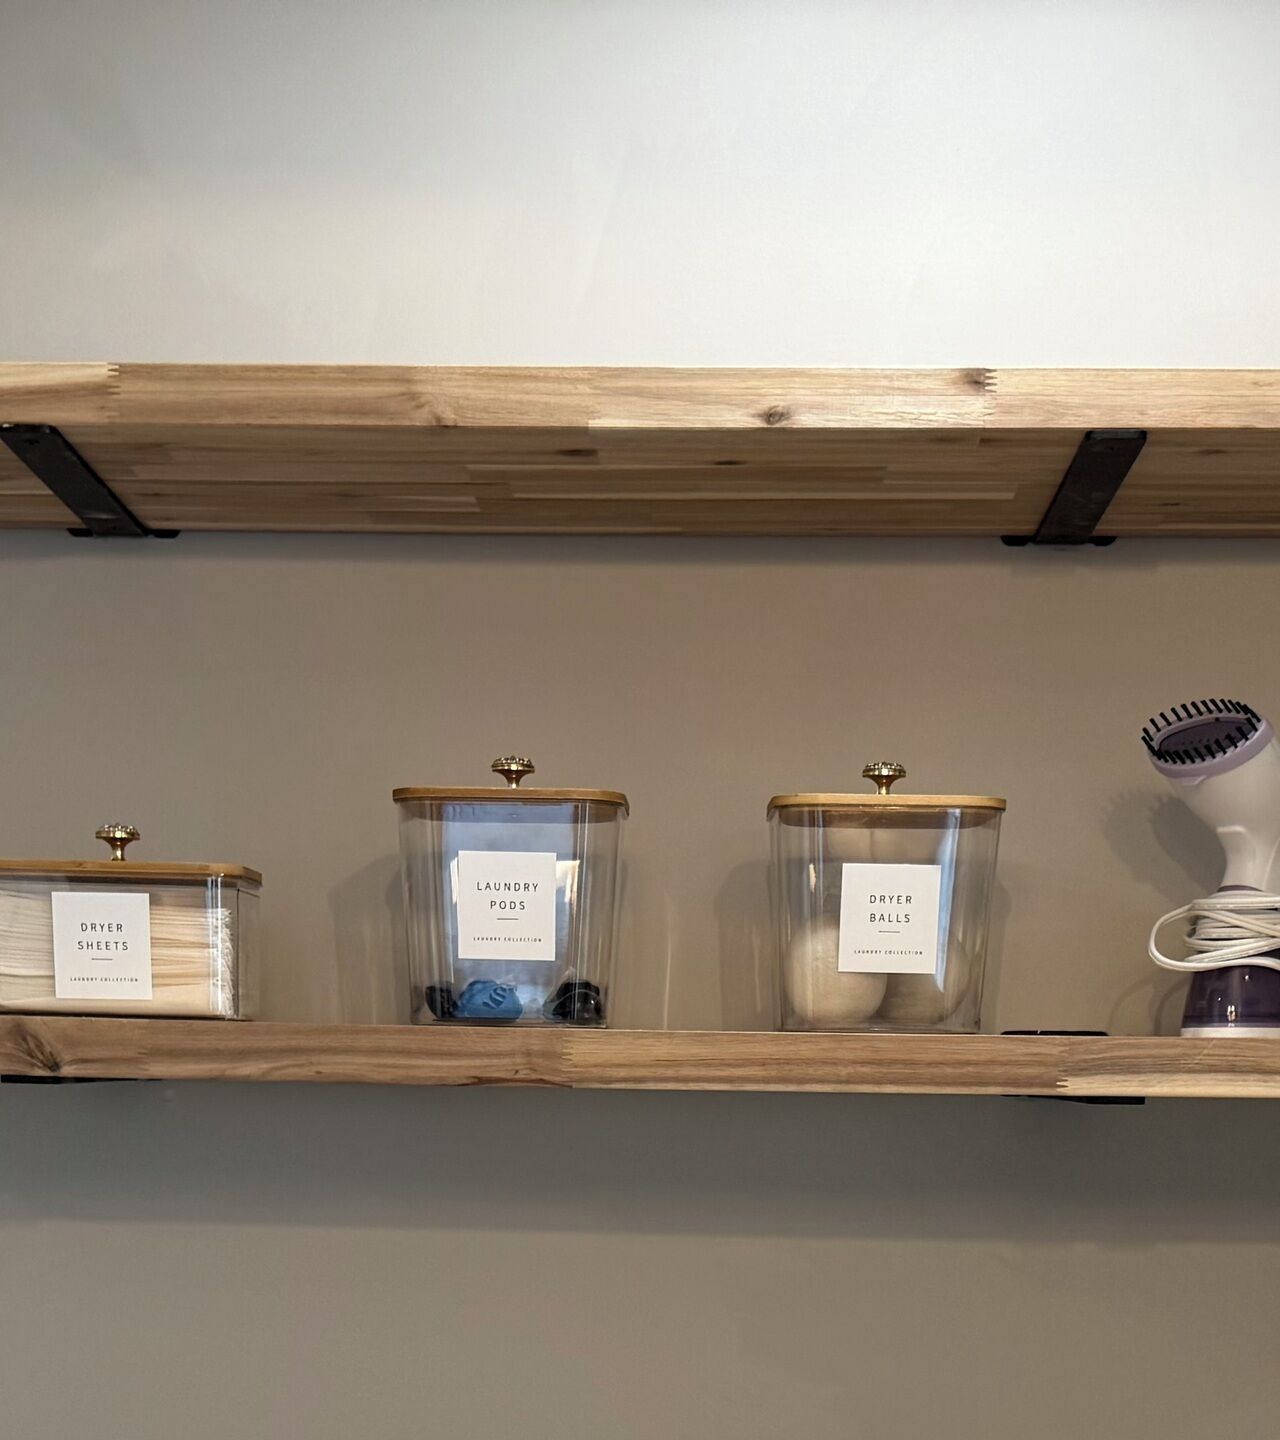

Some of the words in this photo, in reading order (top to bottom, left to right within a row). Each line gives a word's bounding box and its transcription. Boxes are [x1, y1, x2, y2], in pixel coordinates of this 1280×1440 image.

[476, 881, 539, 893] LAUNDRY
[869, 894, 913, 905] DRYER
[490, 900, 526, 911] PODS
[869, 912, 911, 923] BALLS
[80, 922, 124, 933] DRYER
[77, 940, 129, 951] SHEETS
